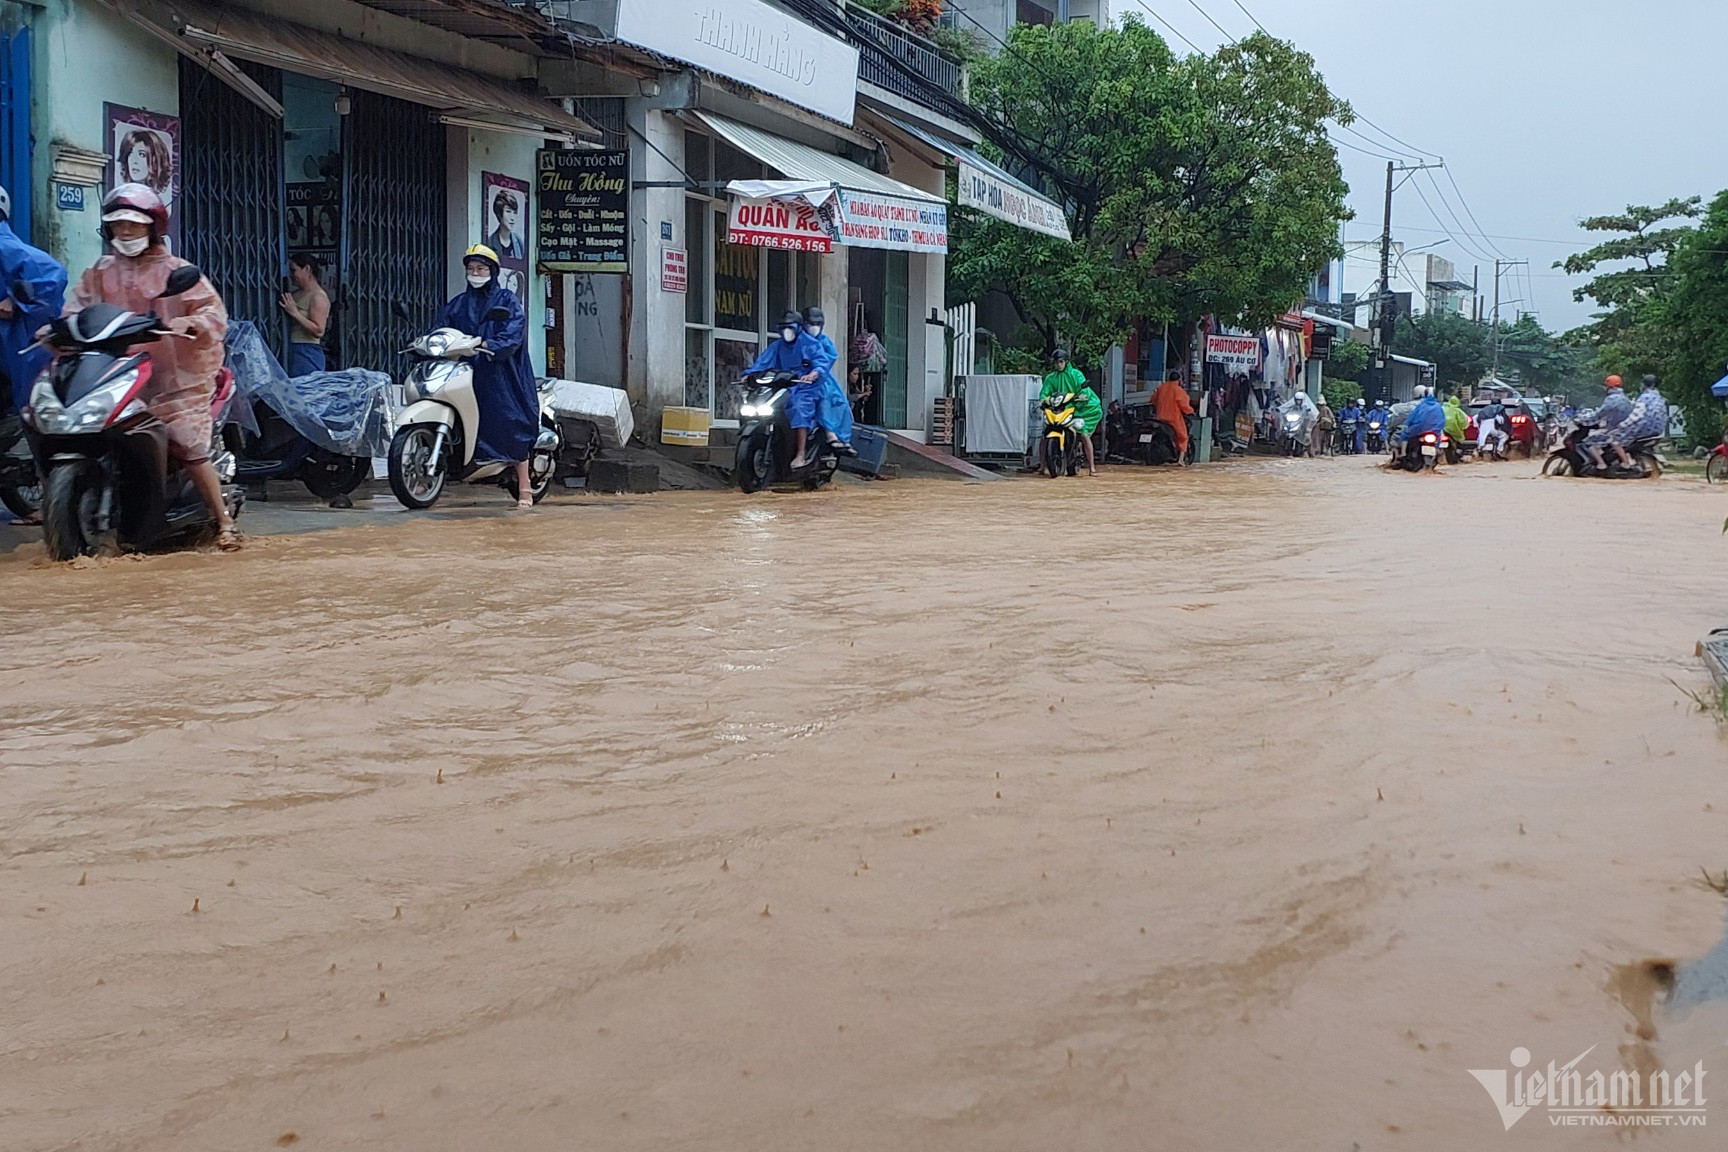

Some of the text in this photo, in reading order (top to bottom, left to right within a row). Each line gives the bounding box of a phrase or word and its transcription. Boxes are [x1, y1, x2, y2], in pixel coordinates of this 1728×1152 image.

[694, 6, 761, 64] THANH
[558, 152, 625, 167] UỐN TÓC NỮ
[541, 171, 625, 195] Thu Hồng
[60, 185, 82, 203] 259
[289, 186, 311, 200] TÓC
[972, 176, 986, 206] TẠP
[988, 181, 1003, 211] HÓA
[737, 202, 791, 229] QUẦN
[540, 222, 625, 235] Sấy Gội Làm Móng
[541, 236, 558, 248] Cạo
[585, 237, 624, 248] Massage
[729, 233, 826, 252] ĐT: 0766.526.156
[1209, 339, 1257, 355] PHOTOCOPPY
